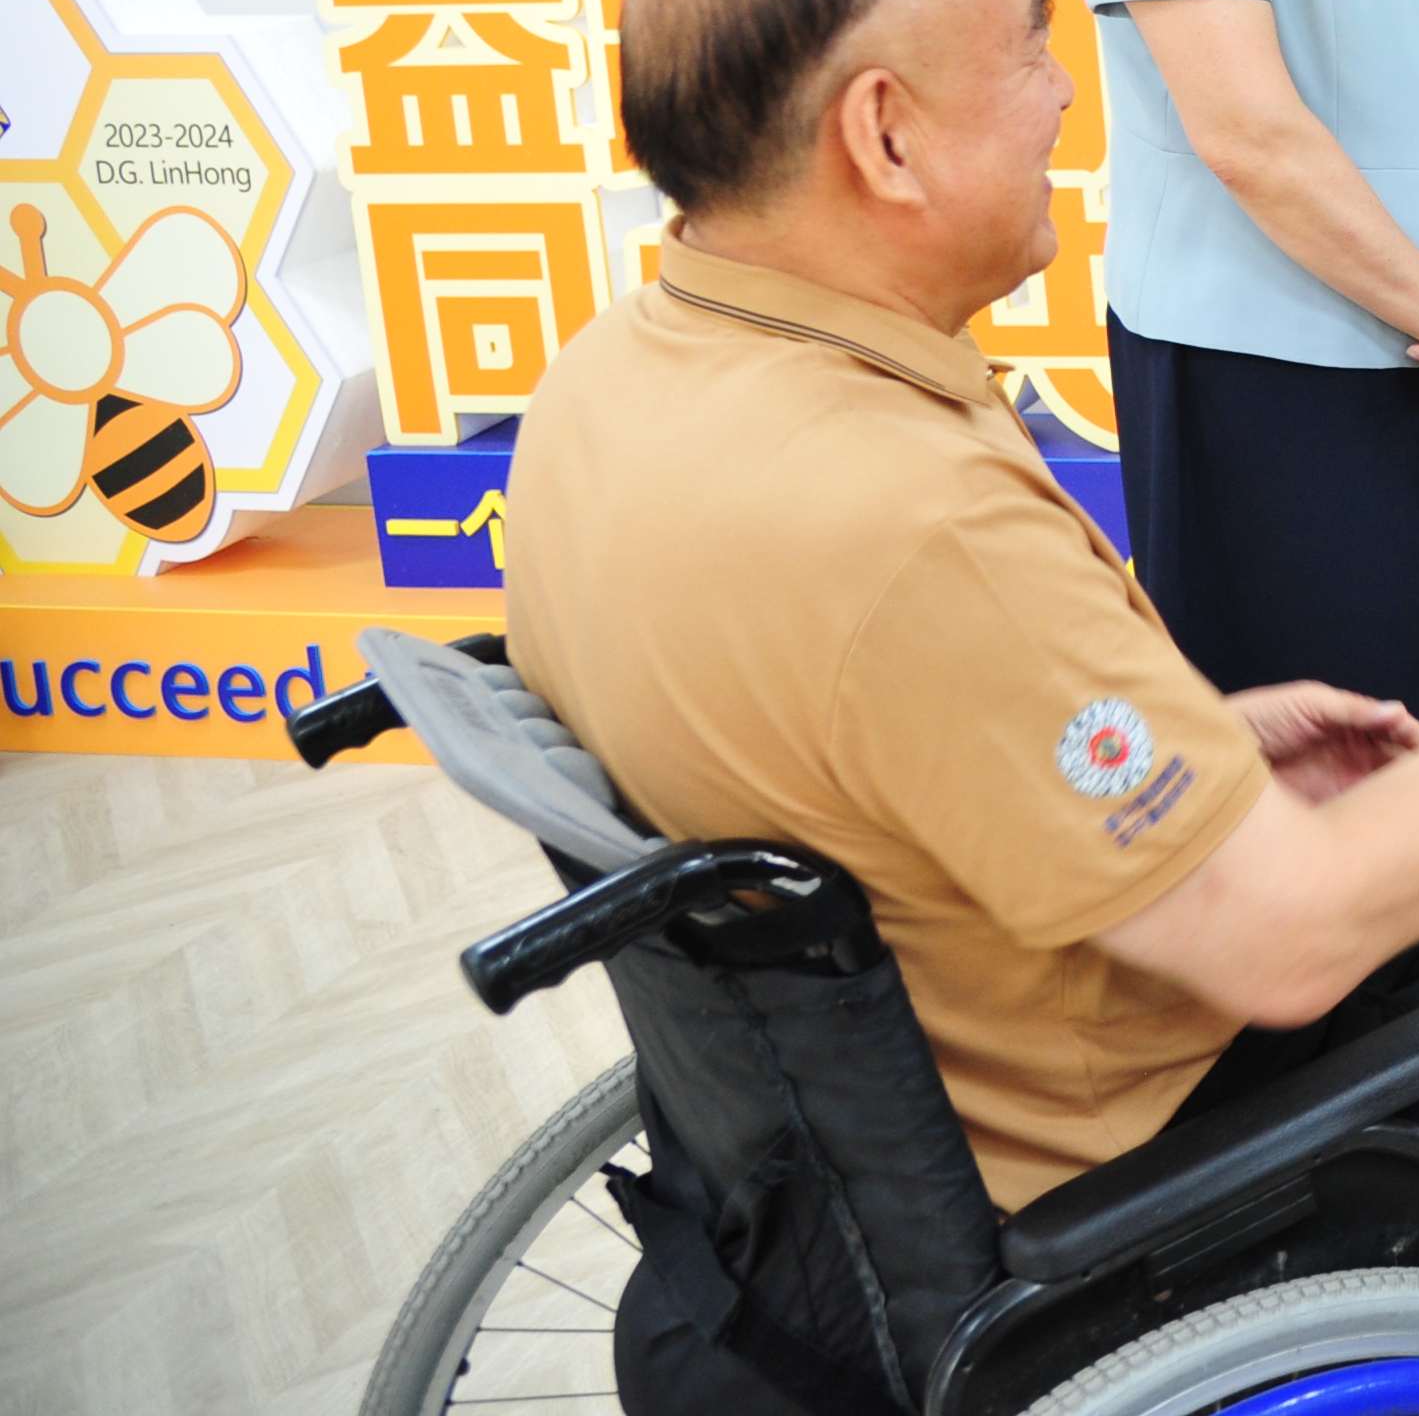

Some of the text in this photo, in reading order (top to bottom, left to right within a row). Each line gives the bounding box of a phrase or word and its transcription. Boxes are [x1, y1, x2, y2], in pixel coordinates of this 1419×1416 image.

[104, 122, 234, 151] 2023-2024
[95, 158, 253, 194] D.G. LinHong
